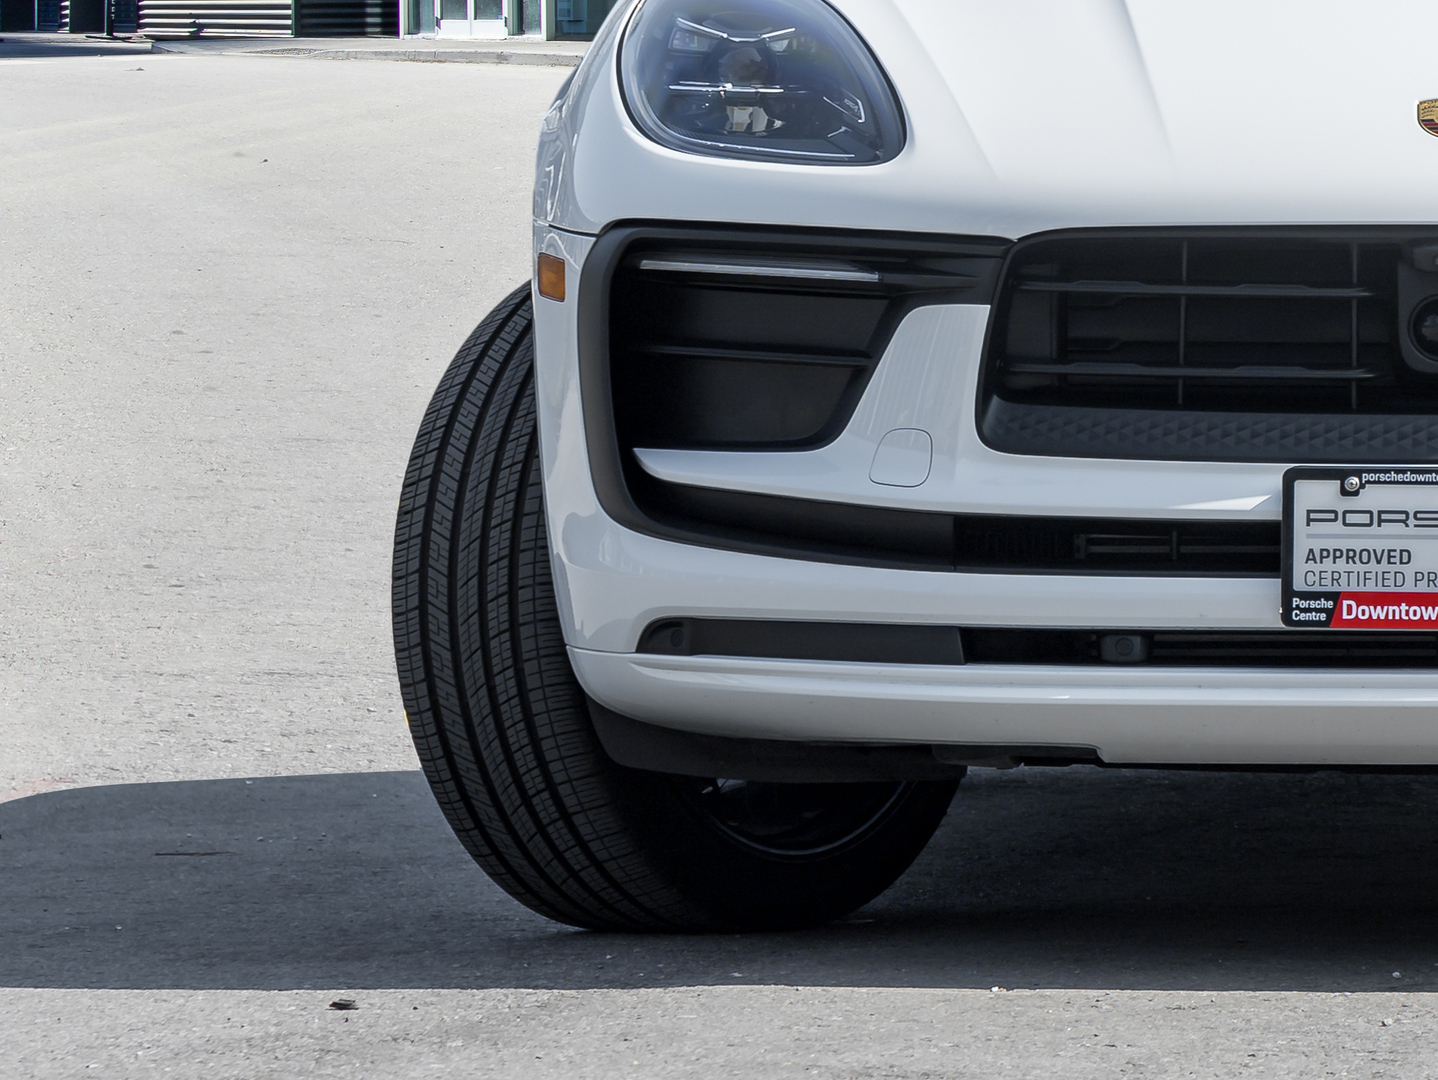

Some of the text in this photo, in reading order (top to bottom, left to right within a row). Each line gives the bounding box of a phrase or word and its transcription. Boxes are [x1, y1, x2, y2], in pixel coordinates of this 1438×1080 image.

[1304, 548, 1412, 565] APPROVED
[1304, 570, 1406, 588] CERTIFIED
[1292, 597, 1334, 609] Porsche
[1292, 610, 1327, 621] Centre
